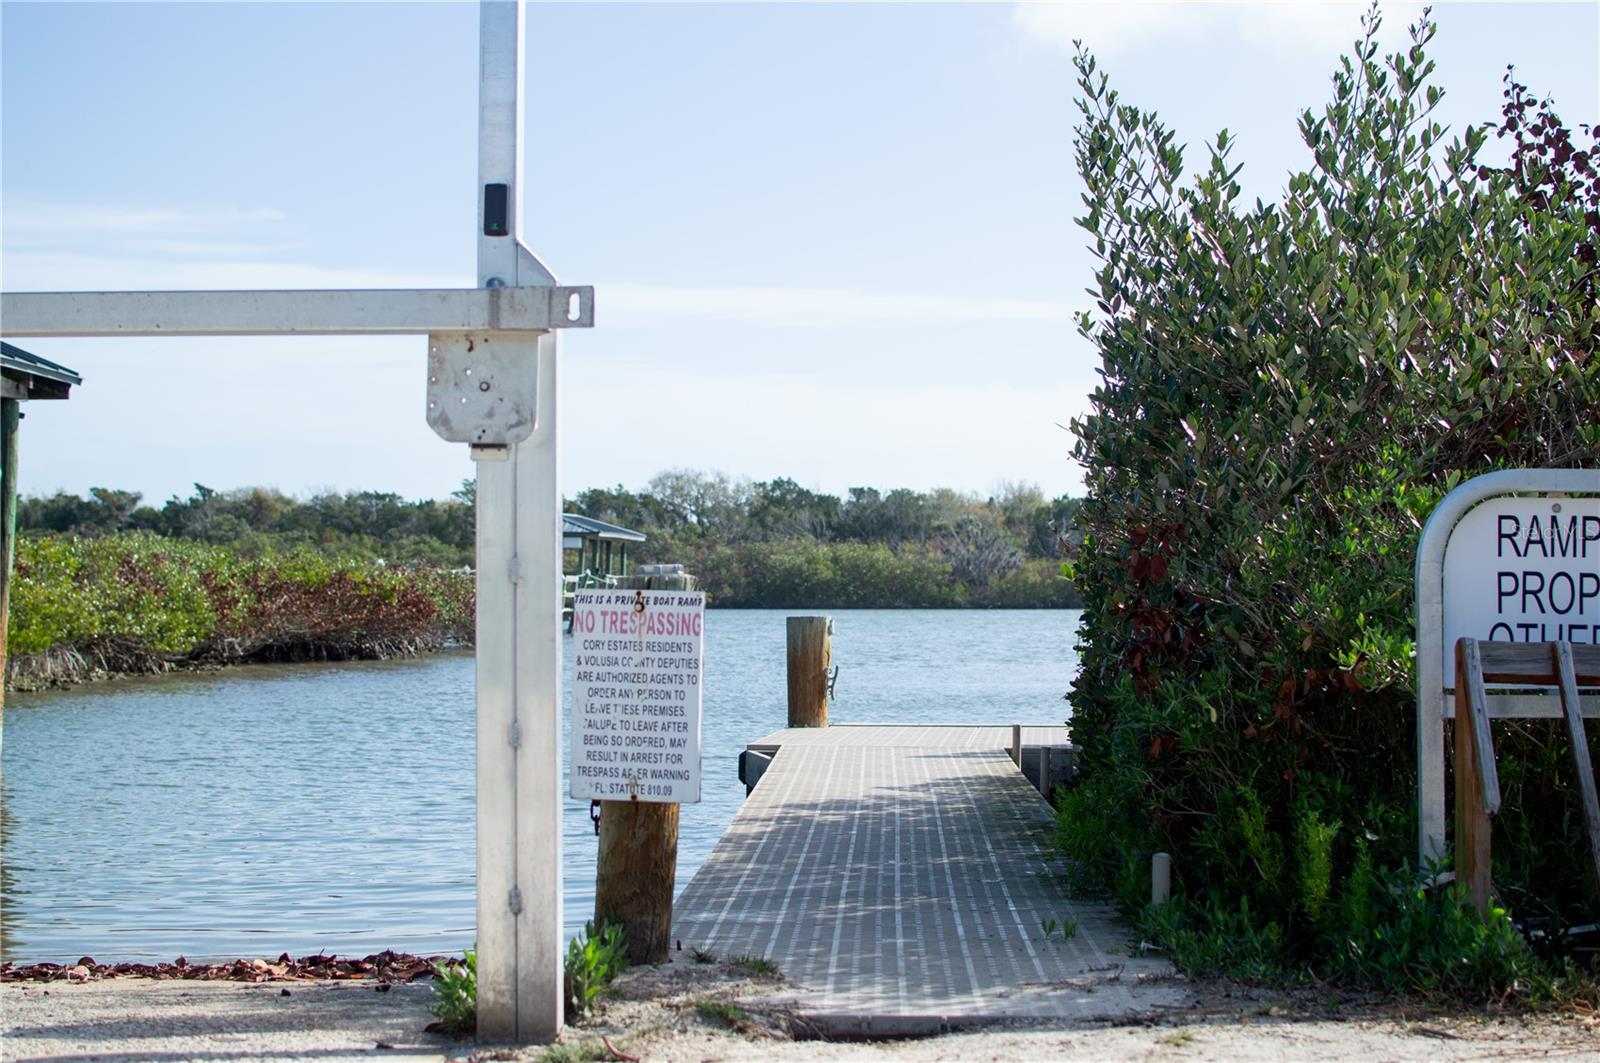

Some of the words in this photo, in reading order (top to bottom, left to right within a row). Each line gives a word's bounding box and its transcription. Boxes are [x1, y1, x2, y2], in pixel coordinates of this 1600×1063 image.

[1497, 514, 1600, 558] RAMP
[575, 594, 593, 605] THIS
[596, 595, 604, 605] IS
[606, 595, 612, 605] A
[614, 595, 650, 606] PRIVTE
[653, 596, 676, 607] BOAT
[677, 596, 702, 607] RAMP
[1497, 571, 1600, 615] PROP
[574, 609, 595, 634] NO
[583, 639, 605, 652] CORY
[607, 640, 643, 653] ESTATES
[645, 641, 693, 654] RESIDENTS
[576, 655, 582, 666] &
[584, 655, 619, 667] VOLUSIA
[657, 658, 699, 670] DEPUTIES
[576, 671, 594, 682] ARE
[595, 671, 648, 684] AUTHORIZED
[649, 673, 684, 685] AGENTS
[686, 674, 698, 686] TO
[587, 687, 616, 699] ORDER
[674, 690, 686, 701] TO
[642, 704, 688, 718] PREMISES.
[619, 719, 631, 731] TO
[632, 720, 659, 732] LEAVE
[660, 721, 689, 733] AFTER
[583, 734, 609, 746] BEING
[610, 735, 623, 747] SO
[669, 738, 688, 749] MAY
[586, 750, 618, 762] RESULT
[620, 751, 629, 763] IN
[630, 752, 663, 764] ARREST
[665, 753, 684, 765] FOR
[577, 765, 620, 778] TRESPASS
[621, 767, 648, 780] AFER
[650, 769, 690, 781] WARNING
[609, 783, 646, 796] STATUTE
[647, 785, 673, 796] 810.09
